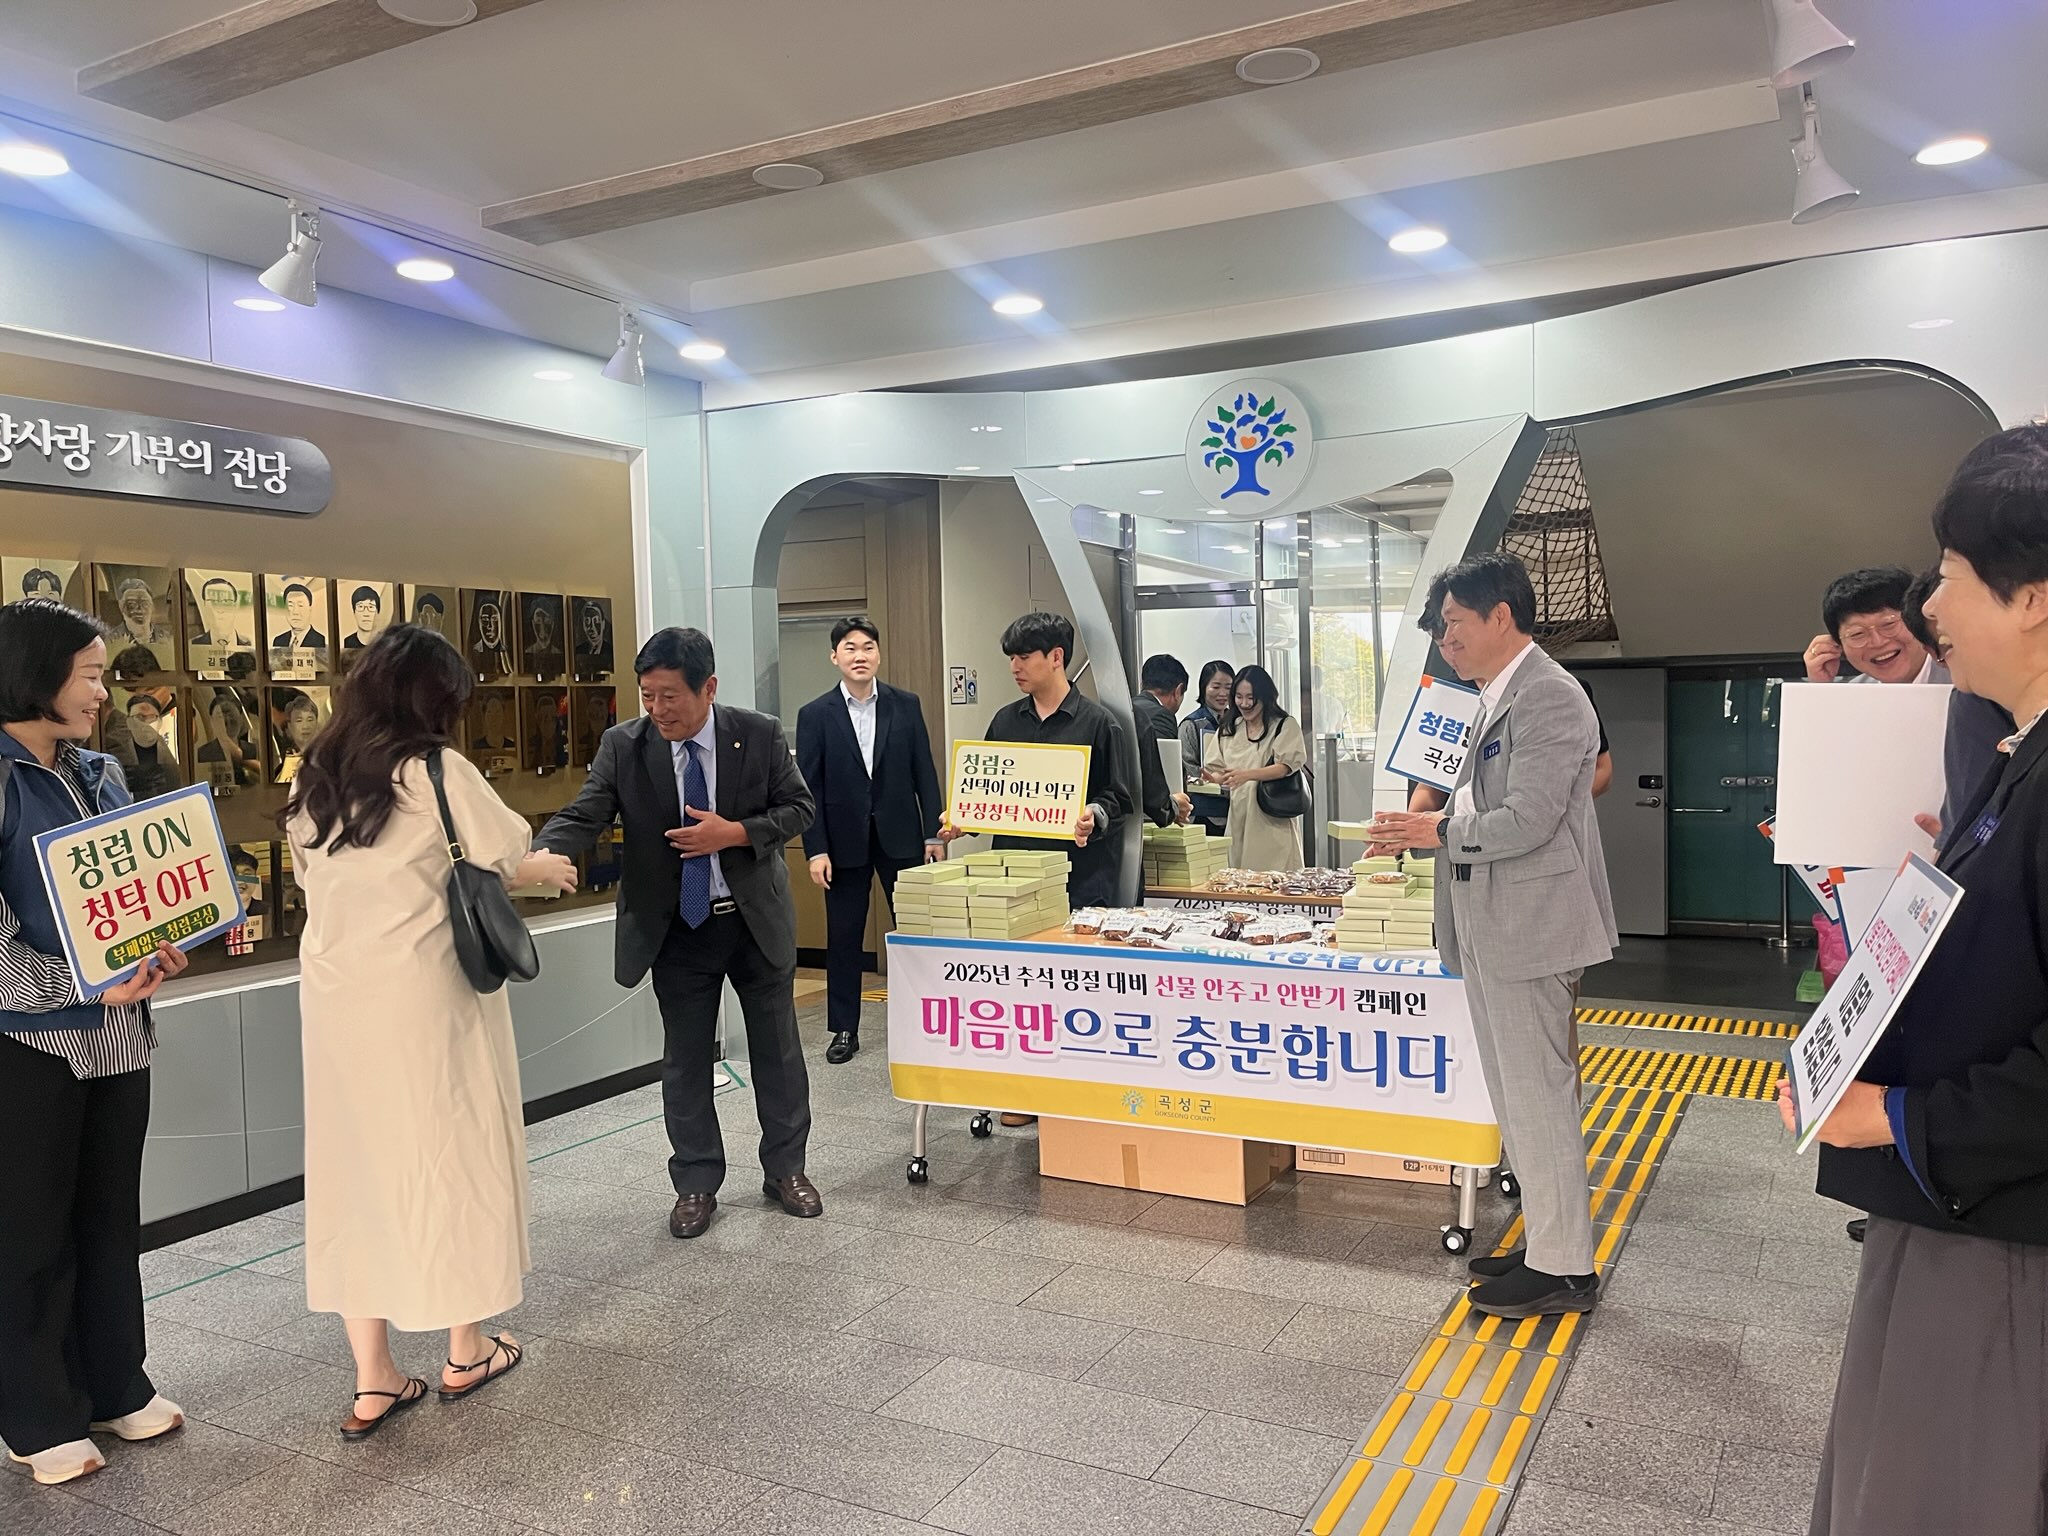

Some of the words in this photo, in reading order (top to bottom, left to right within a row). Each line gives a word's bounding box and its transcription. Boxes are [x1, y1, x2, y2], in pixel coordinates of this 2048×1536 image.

[105, 430, 212, 475] 기부의
[223, 447, 291, 494] 전당
[963, 753, 1016, 776] 청렴은
[960, 777, 1006, 797] 선택이
[1009, 780, 1040, 799] 아닌
[1044, 782, 1077, 801] 의무
[957, 801, 1020, 823] 부정청탁
[1022, 806, 1067, 825] NO!!!
[66, 828, 138, 890] 청렴
[142, 812, 192, 860] ON
[81, 878, 152, 942] 청탁
[156, 854, 215, 908] OFF
[166, 904, 215, 940] 청렴곡성
[943, 962, 1010, 986] 2025년
[1017, 966, 1054, 990] 추석
[1061, 968, 1100, 993] 명절
[1106, 971, 1148, 996] 대비
[1154, 974, 1197, 1000] 선물
[1203, 978, 1271, 1003] 안주고
[1277, 983, 1346, 1011] 안받기
[1353, 988, 1427, 1017] 캠페인
[921, 996, 1158, 1060] 마음만으로
[1172, 1015, 1454, 1094] 충분합니다
[1158, 1095, 1212, 1114] 곡성군
[1189, 1114, 1216, 1122] COUNTY
[1405, 1161, 1419, 1171] 12P
